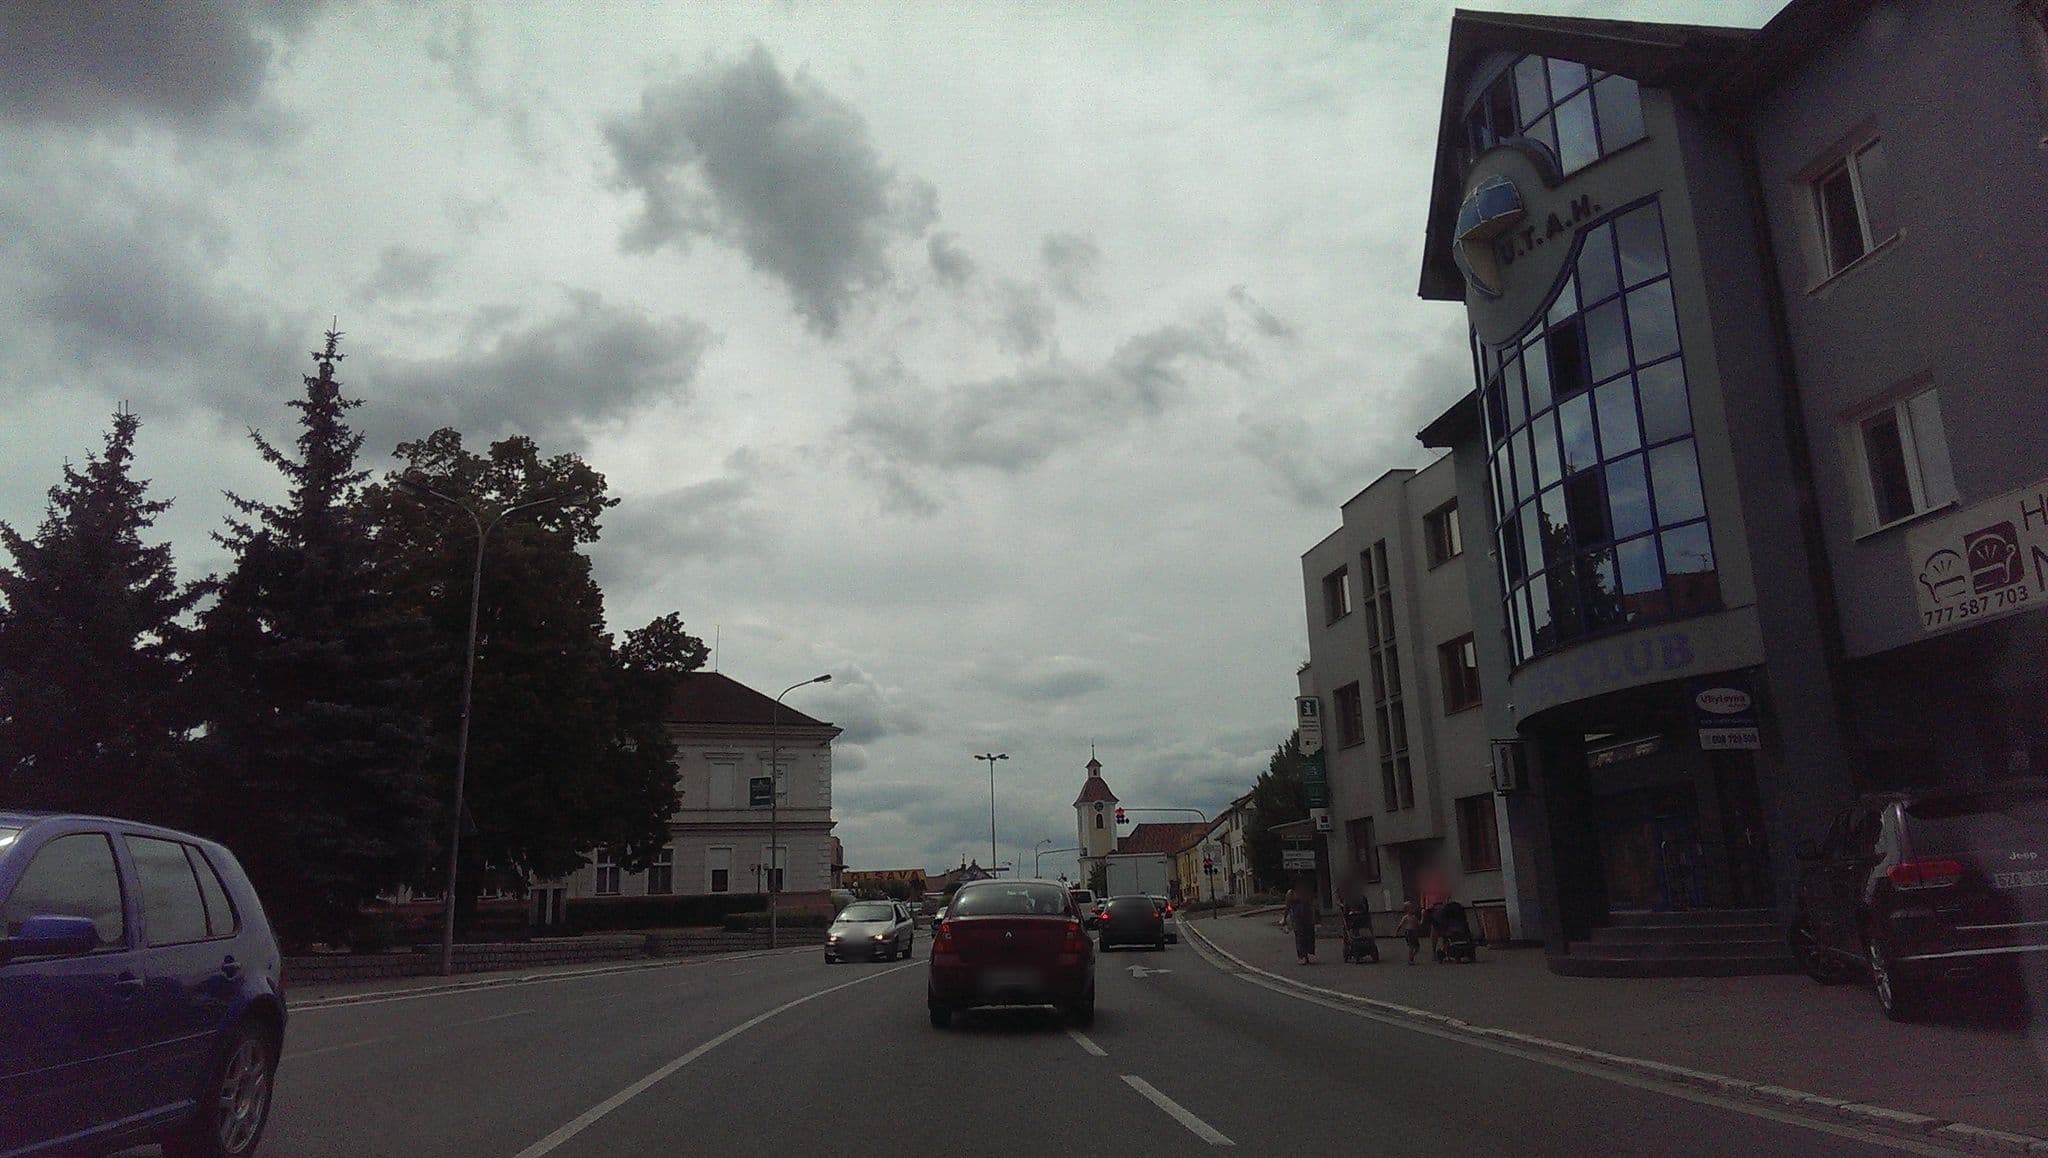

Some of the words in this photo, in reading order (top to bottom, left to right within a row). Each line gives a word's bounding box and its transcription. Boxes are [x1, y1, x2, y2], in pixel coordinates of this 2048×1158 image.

[1923, 606, 1954, 626] 777
[1959, 596, 1989, 618] 587
[1995, 584, 2029, 608] 703
[1571, 633, 1695, 689] CLUB
[2009, 851, 2038, 861] Jeep
